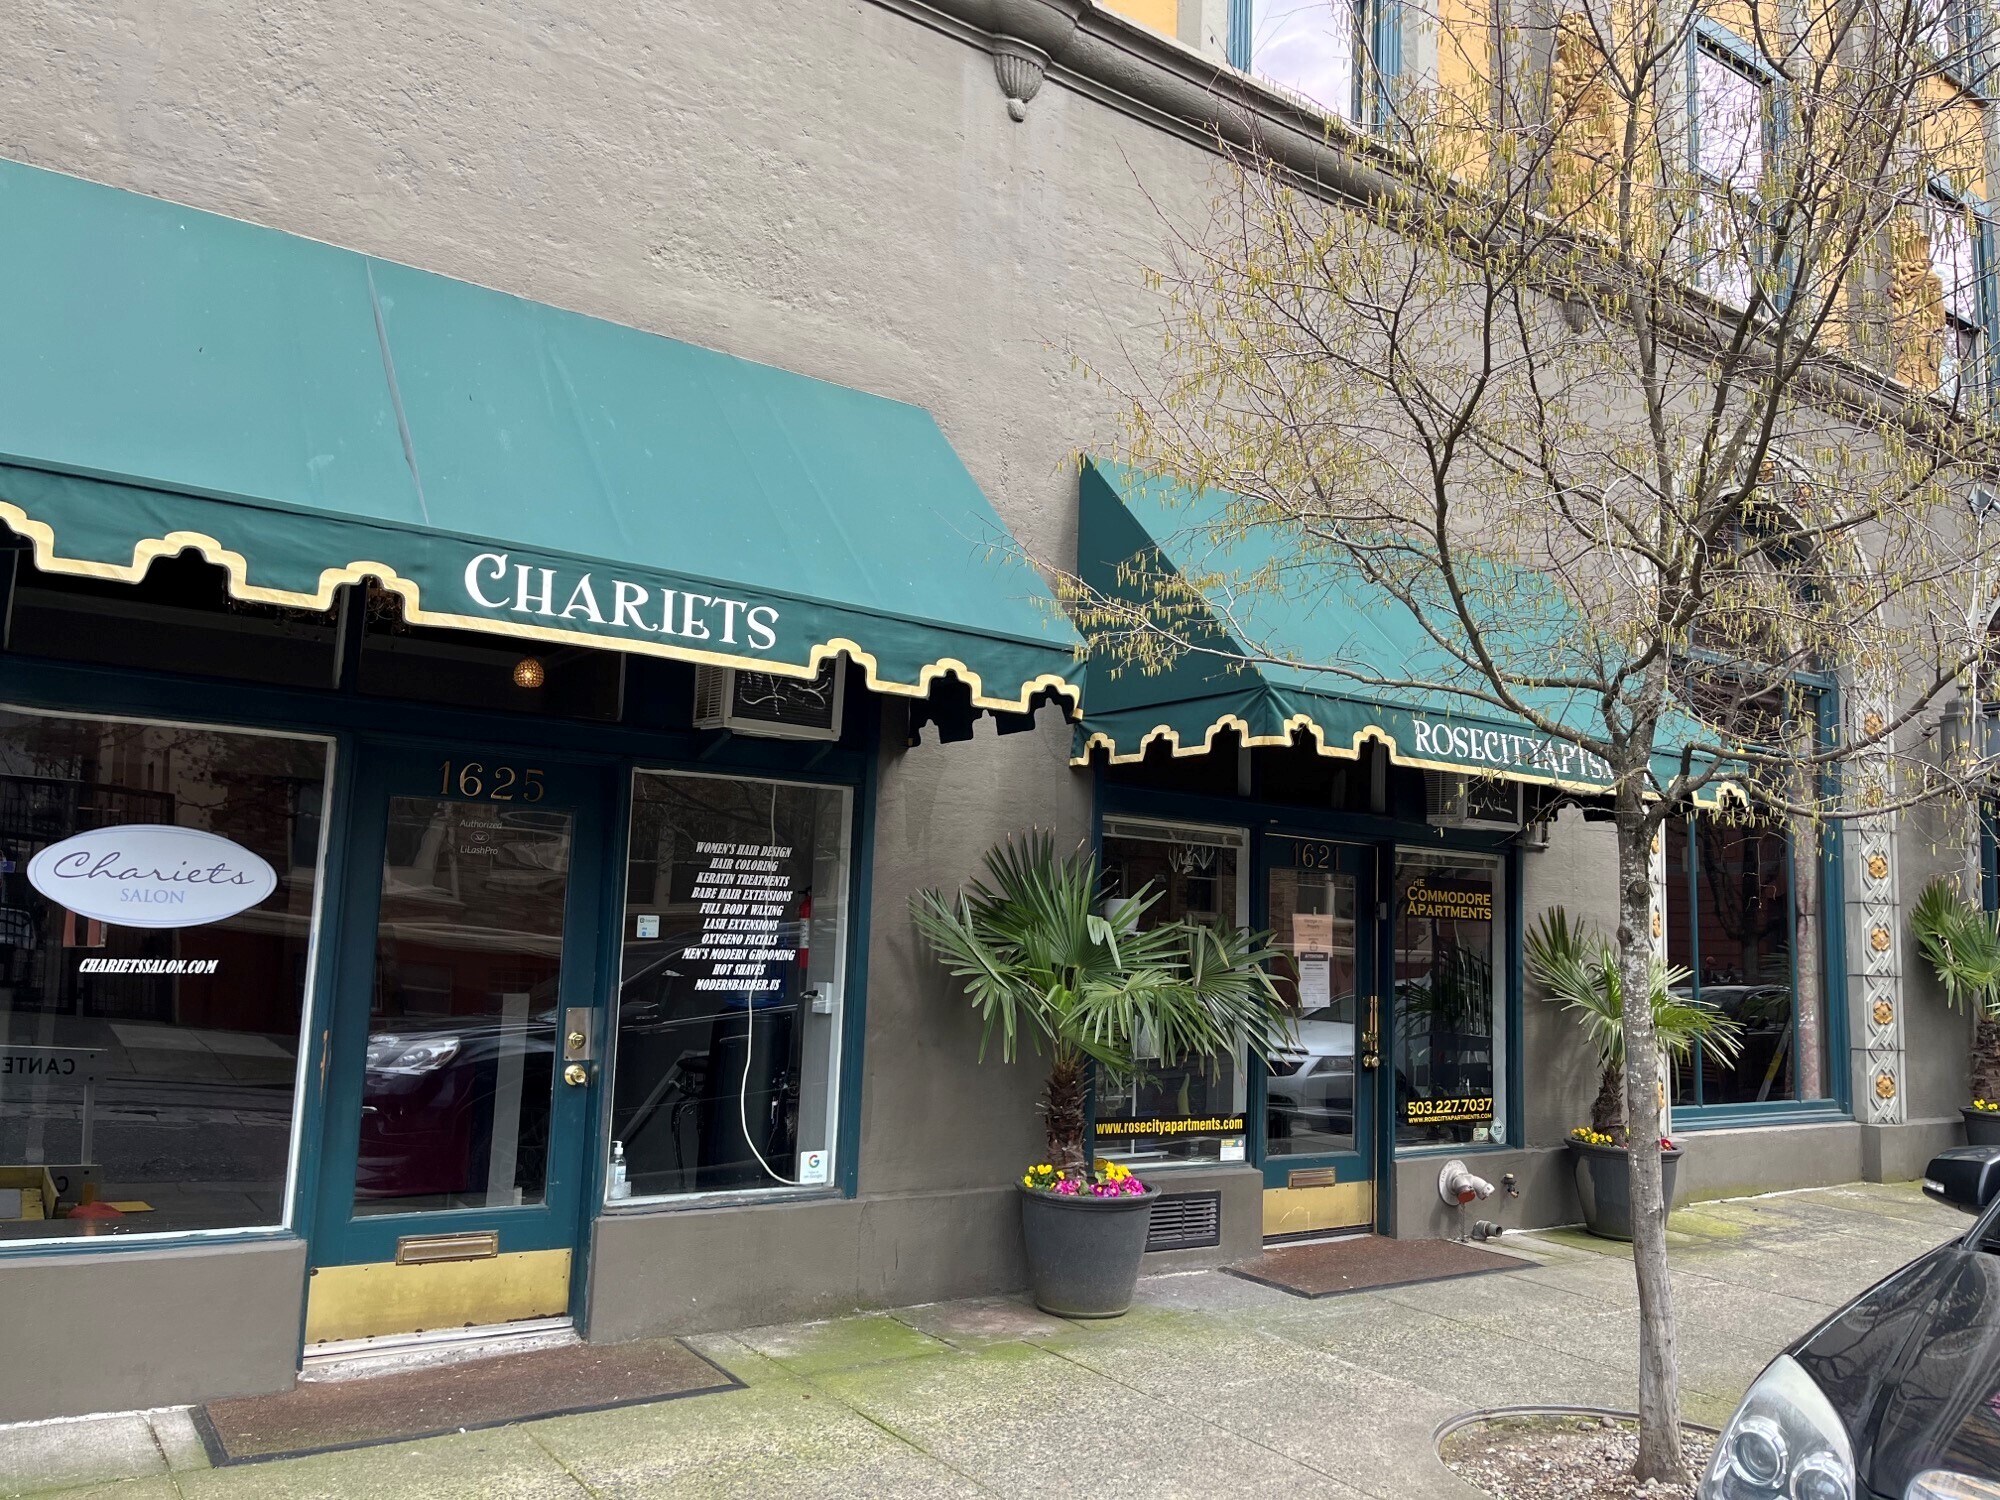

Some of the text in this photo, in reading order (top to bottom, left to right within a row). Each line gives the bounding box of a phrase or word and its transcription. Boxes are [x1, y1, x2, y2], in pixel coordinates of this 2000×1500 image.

[464, 553, 780, 650] CHARIETS
[439, 760, 545, 802] 1625
[460, 819, 503, 829] Authorized
[696, 841, 793, 858] WOMEN'S HAIR DESIGN
[1292, 842, 1340, 871] 1621
[53, 851, 255, 885] Chariets
[709, 858, 779, 871] HAIR COLORING
[696, 872, 790, 887] KERATIN TREATMENTS
[1412, 879, 1425, 887] HE
[120, 888, 185, 904] SALON
[691, 887, 793, 902] BABE HAIR EXTENSIONS
[1407, 886, 1492, 906] COMMODORE
[699, 903, 785, 917] FULL BODY WAXING
[1407, 901, 1492, 919] APARTMENTS
[703, 918, 779, 931] LASH EXTENSIONS
[701, 933, 779, 946] OXYGENO FACIALS
[682, 948, 796, 961] MEN'S MODERN GROOMING
[79, 958, 219, 974] CHARIETSSALON.COM
[712, 964, 766, 976] HOT SHAVES
[694, 979, 781, 991] MODERNBARBER.US
[1408, 1098, 1492, 1115] 503.227.7037
[1408, 1113, 1492, 1123] WWW.ROSECITYAPARTMENTS.COM
[1096, 1117, 1243, 1135] www.rosecityapartments.com
